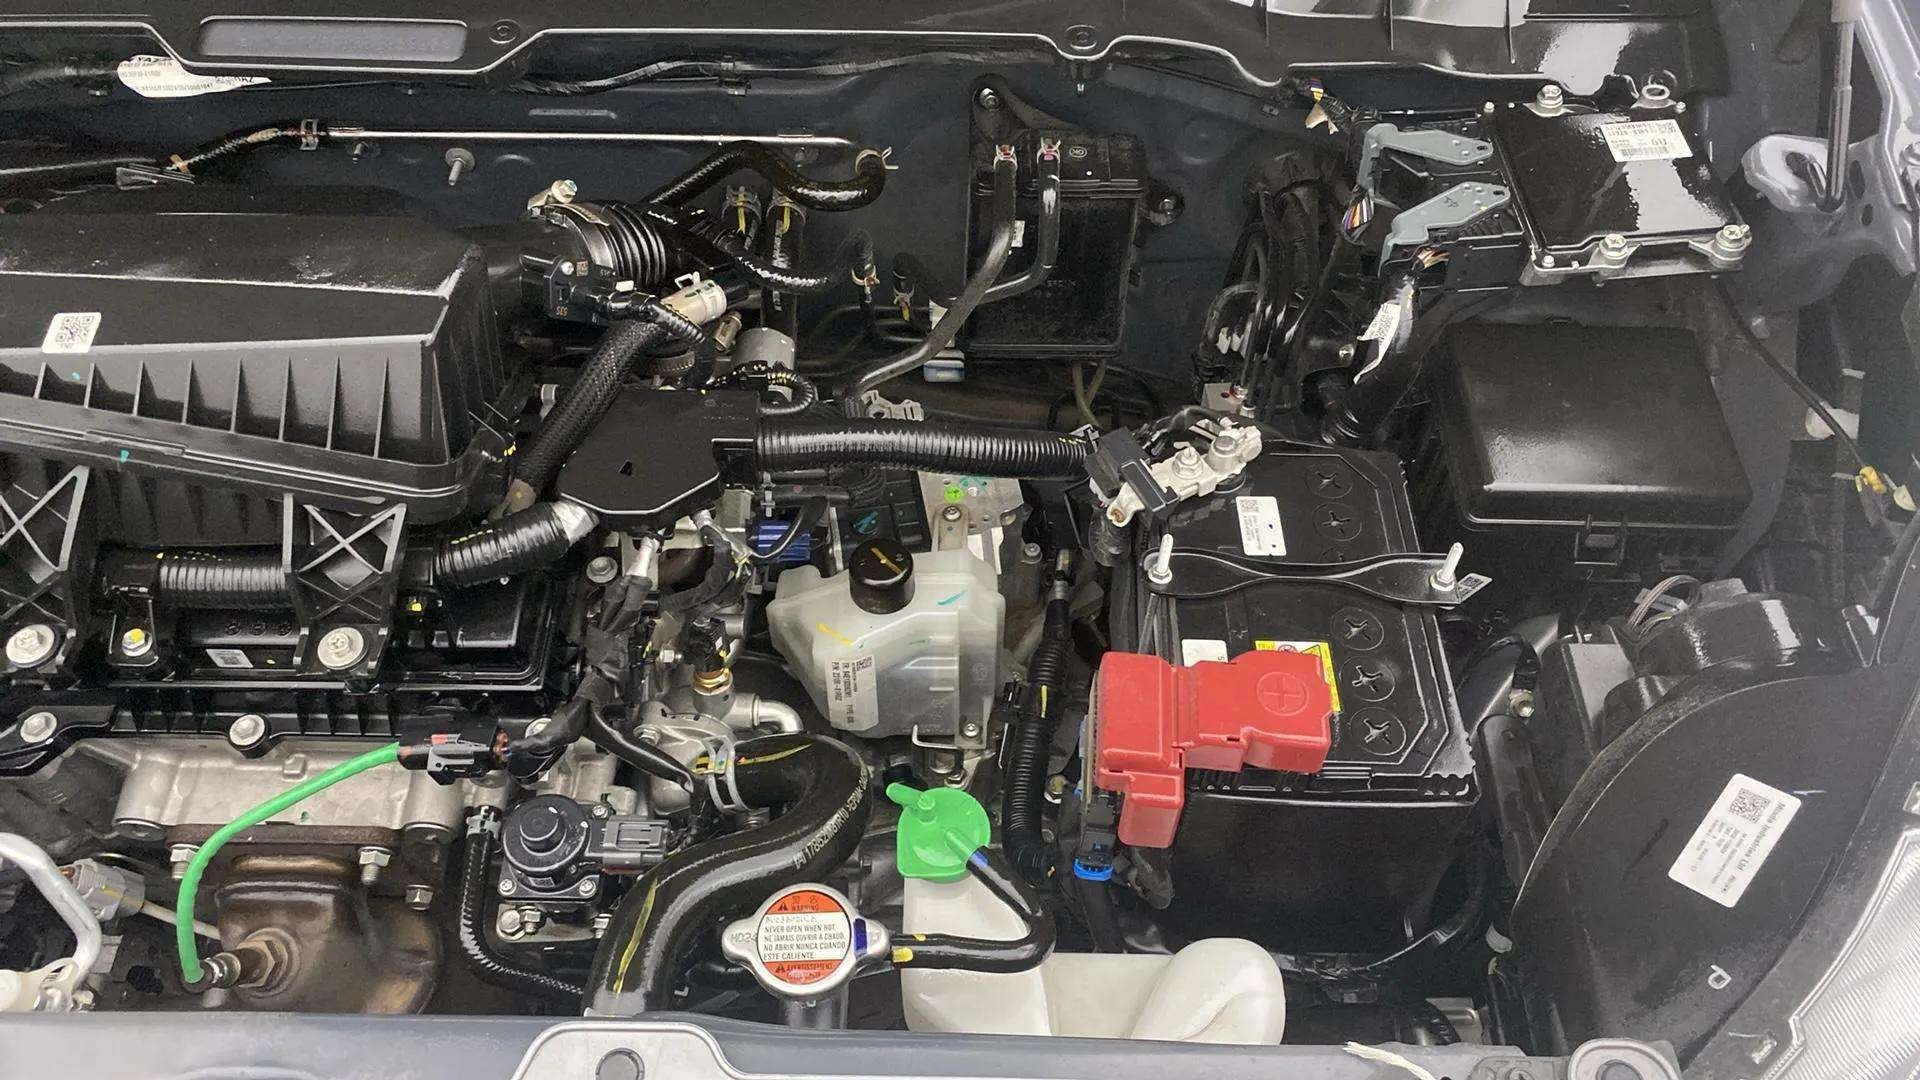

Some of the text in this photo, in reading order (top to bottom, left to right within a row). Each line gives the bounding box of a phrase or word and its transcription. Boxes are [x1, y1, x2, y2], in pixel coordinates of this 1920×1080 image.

[764, 925, 785, 933] NEVER
[786, 925, 803, 933] OPEN
[804, 923, 822, 932] WHEN
[764, 934, 773, 942] NE
[796, 933, 818, 941] OUVRIR
[764, 941, 846, 951] NO ABRIR NUNCA CUANDO
[763, 952, 780, 960] ESTE
